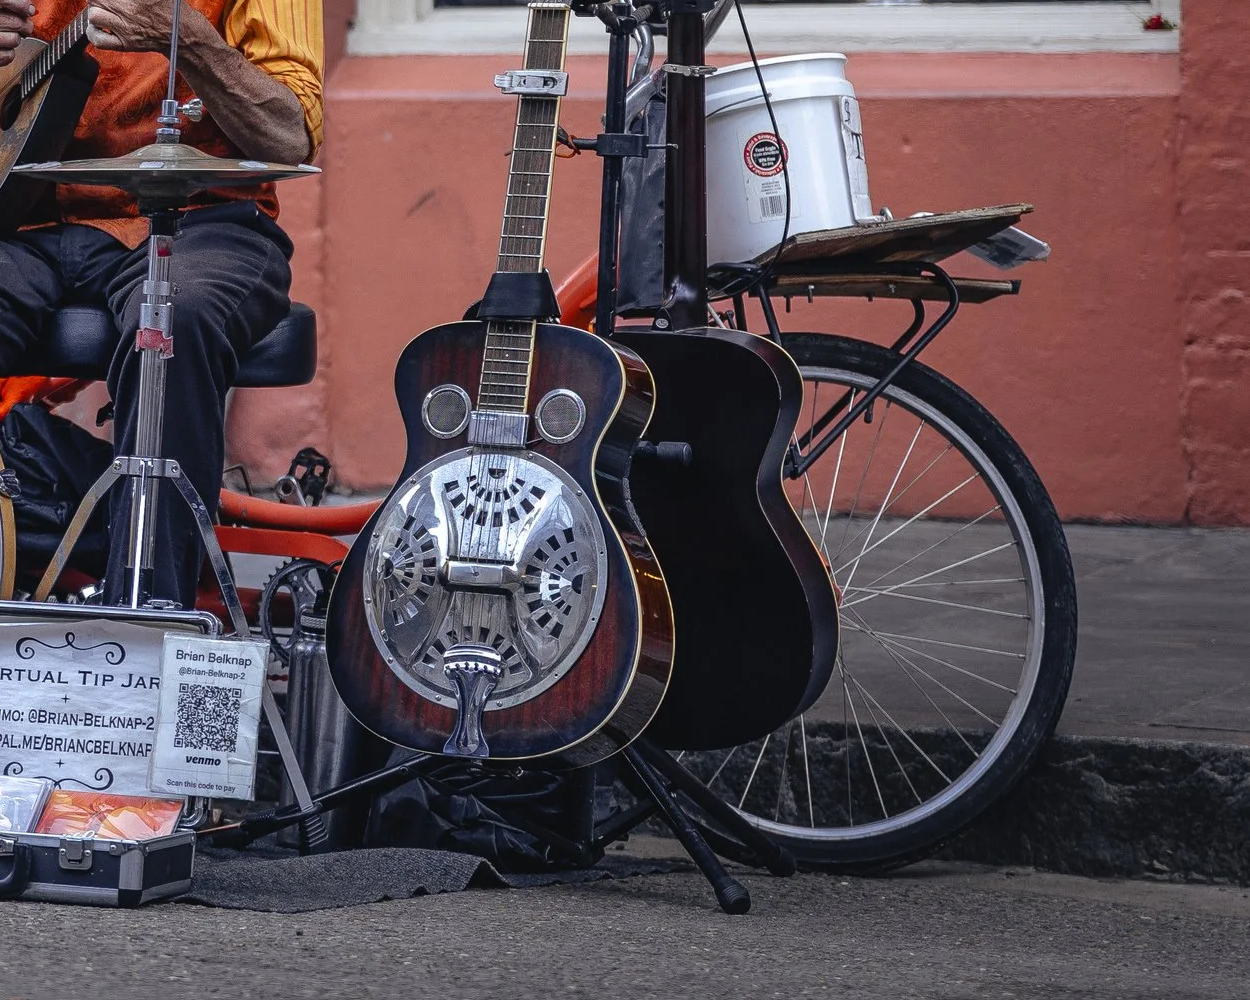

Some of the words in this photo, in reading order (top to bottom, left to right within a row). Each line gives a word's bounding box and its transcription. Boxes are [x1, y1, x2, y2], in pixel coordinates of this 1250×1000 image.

[176, 649, 205, 663] Brian
[208, 652, 252, 669] Belknap
[78, 670, 114, 687] TIP
[178, 666, 246, 681] @Brian-Belknap-2
[185, 755, 221, 767] venmo
[166, 778, 183, 787] Scan
[184, 780, 197, 789] this
[198, 781, 214, 790] code
[215, 783, 223, 791] to
[223, 785, 236, 793] pay
